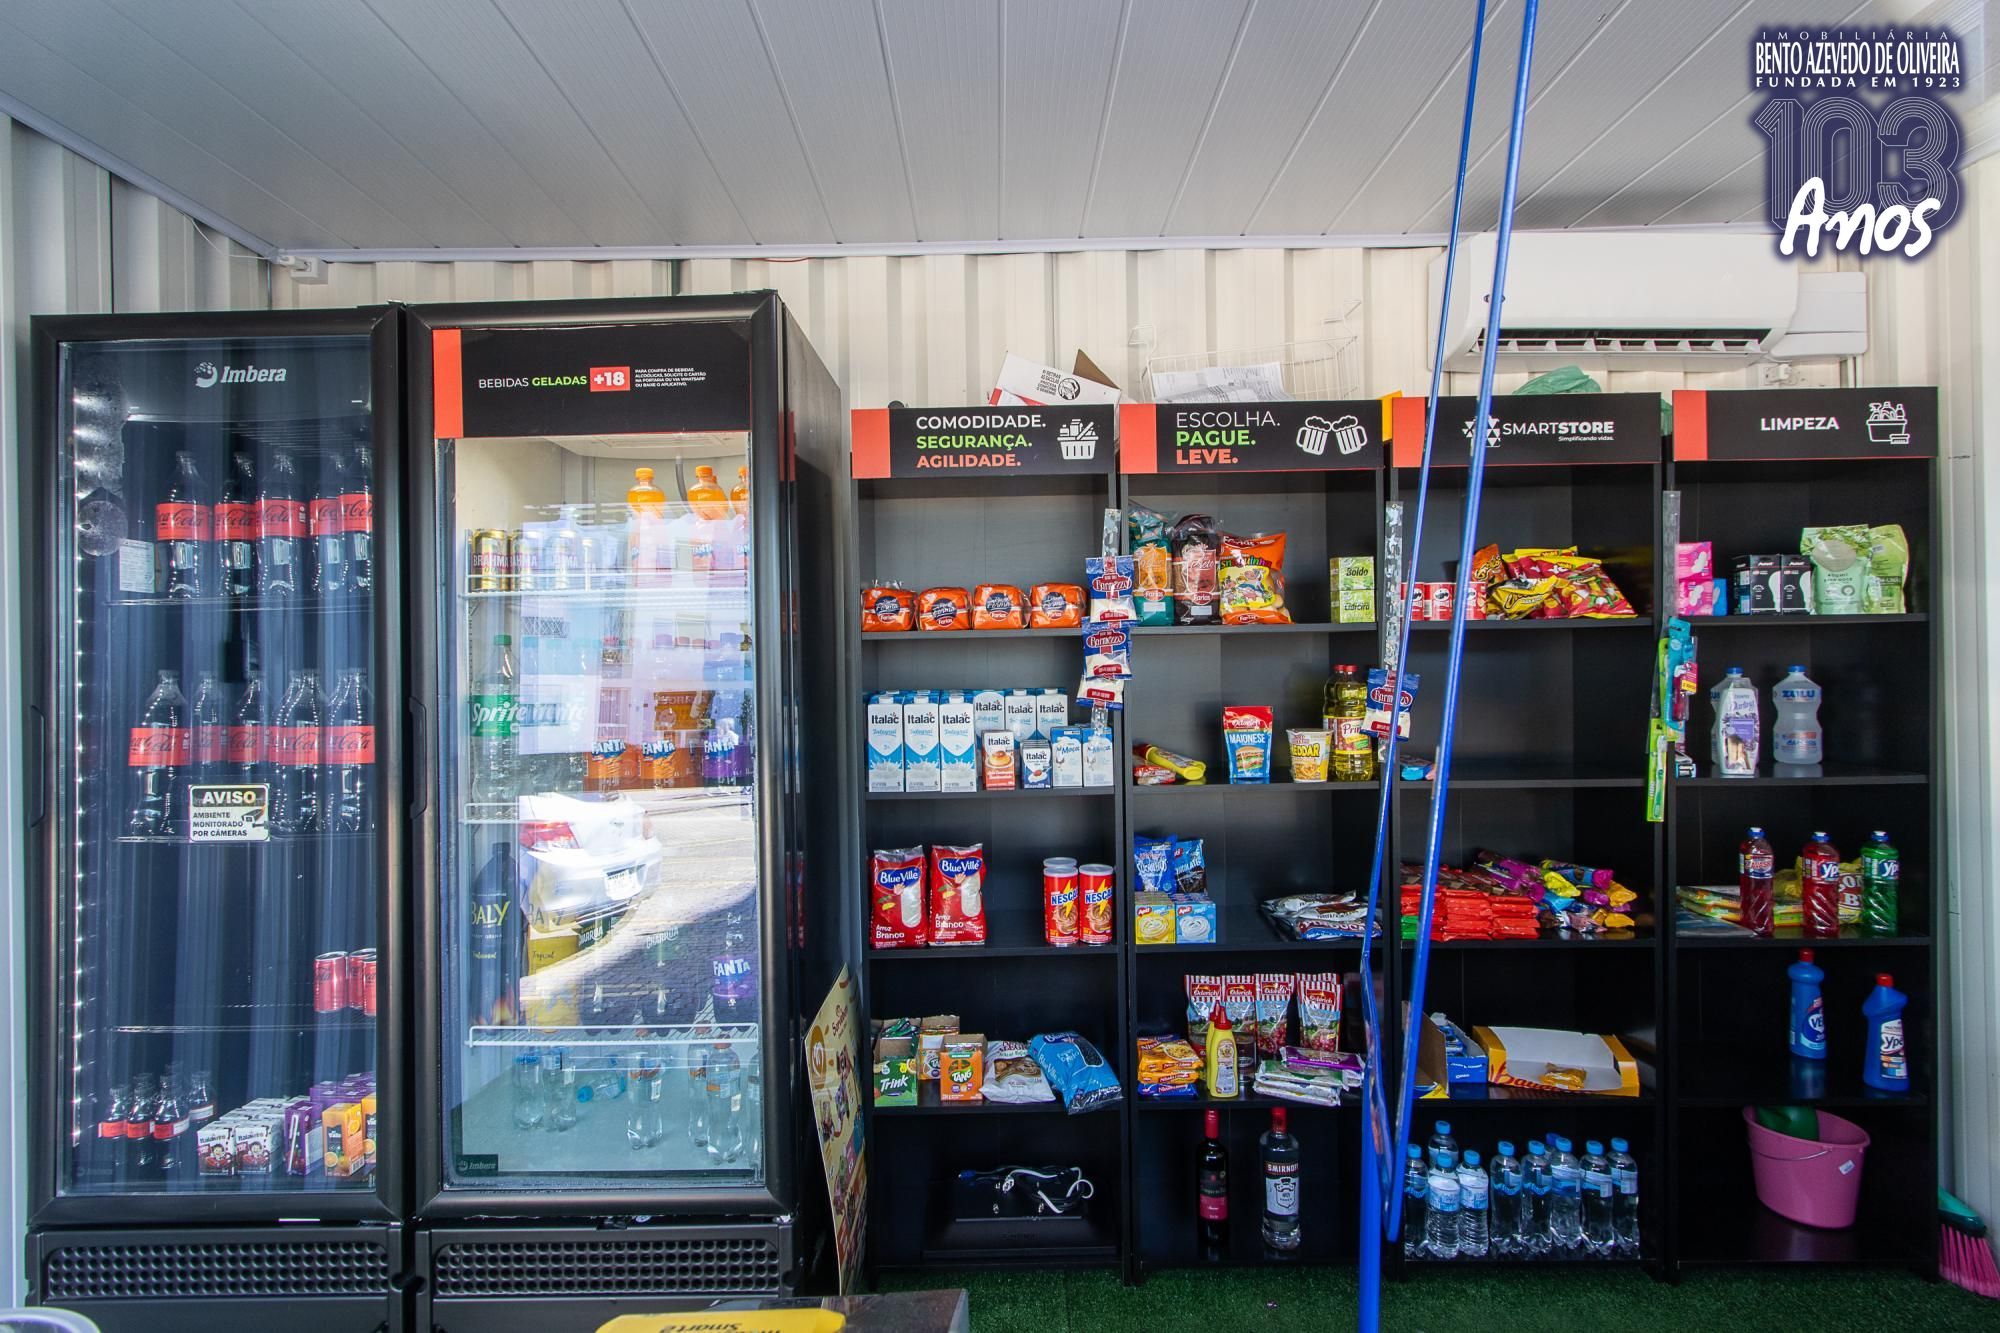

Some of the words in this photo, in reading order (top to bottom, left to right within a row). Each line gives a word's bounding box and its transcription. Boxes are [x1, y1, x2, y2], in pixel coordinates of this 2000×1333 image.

[220, 366, 287, 383] Imbera
[478, 377, 529, 389] BEBIDAS
[531, 376, 587, 387] GELADAS
[594, 372, 625, 386] +18
[916, 415, 1046, 430] COMODIDADE.
[1176, 411, 1281, 428] ESCOLHA.
[1760, 417, 1840, 431] LIMPEZA
[1503, 421, 1614, 435] SMARTSTORE
[916, 434, 1032, 451] SEGURANÇA.
[1176, 430, 1256, 446] PAGUE.
[916, 453, 1021, 468] AGILIDADE.
[1176, 448, 1239, 465] LEVE.
[975, 701, 1003, 712] Italac
[1008, 704, 1034, 714] Italac
[1039, 704, 1065, 714] Italac
[473, 702, 527, 726] Sprite
[871, 714, 900, 724] Italac
[907, 714, 936, 724] Italac
[942, 714, 971, 724] Italac
[988, 737, 1010, 746] Italac
[1229, 733, 1266, 744] MAIONESE
[592, 739, 626, 754] FANTA
[642, 739, 675, 754] FANTA
[1026, 752, 1047, 760] Italac
[202, 791, 257, 804] AVISO
[193, 820, 244, 828] MONITORADO
[935, 921, 964, 929] Branco
[713, 958, 750, 977] FANTA
[880, 1075, 909, 1092] Trink
[951, 1071, 972, 1082] TANG
